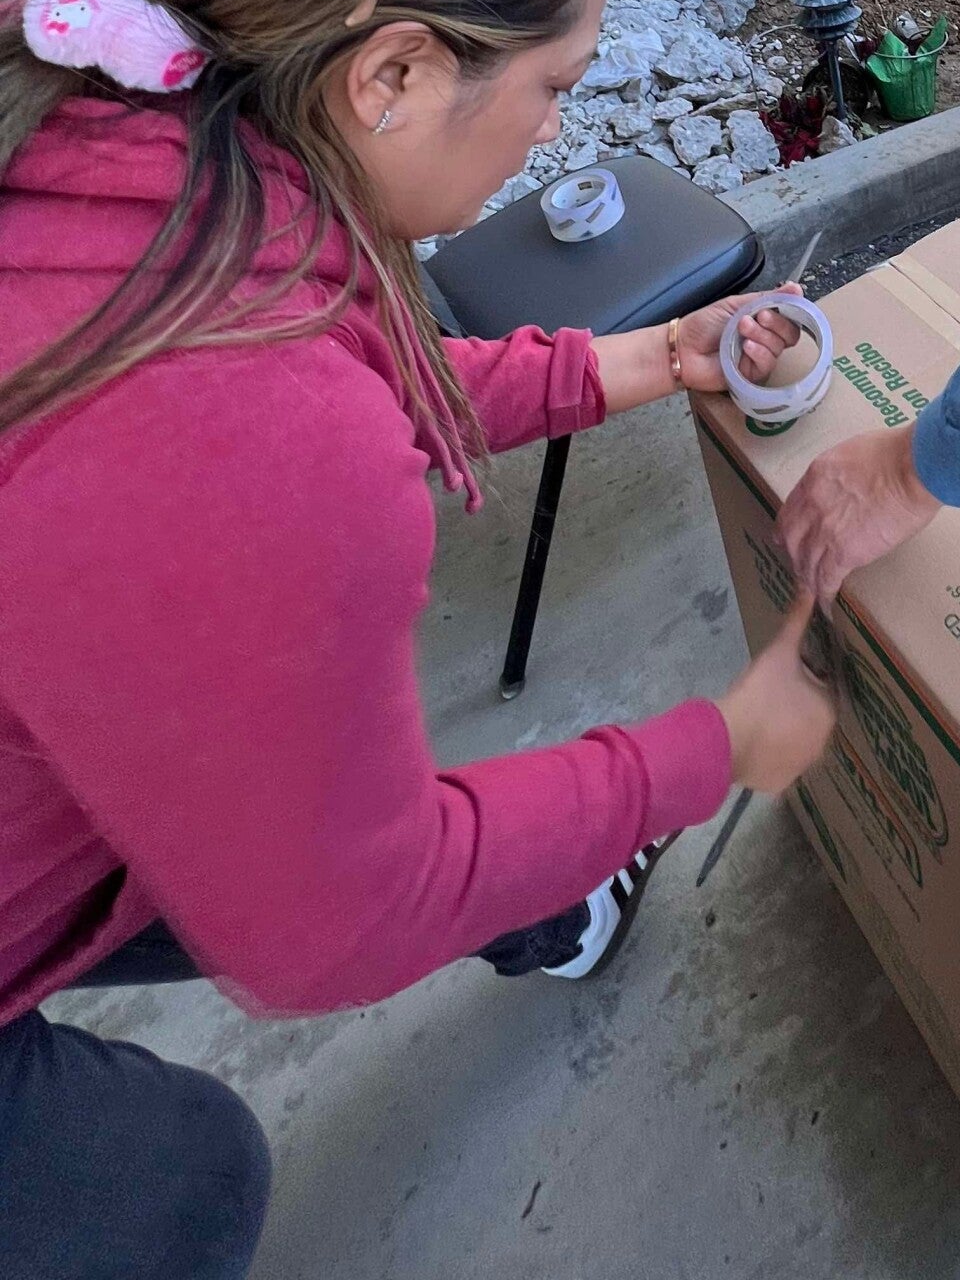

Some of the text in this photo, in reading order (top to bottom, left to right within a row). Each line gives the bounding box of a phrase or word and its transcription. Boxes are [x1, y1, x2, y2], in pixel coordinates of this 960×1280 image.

[825, 351, 914, 430] Recompra
[848, 339, 911, 394] Recibo
[899, 385, 932, 413] on
